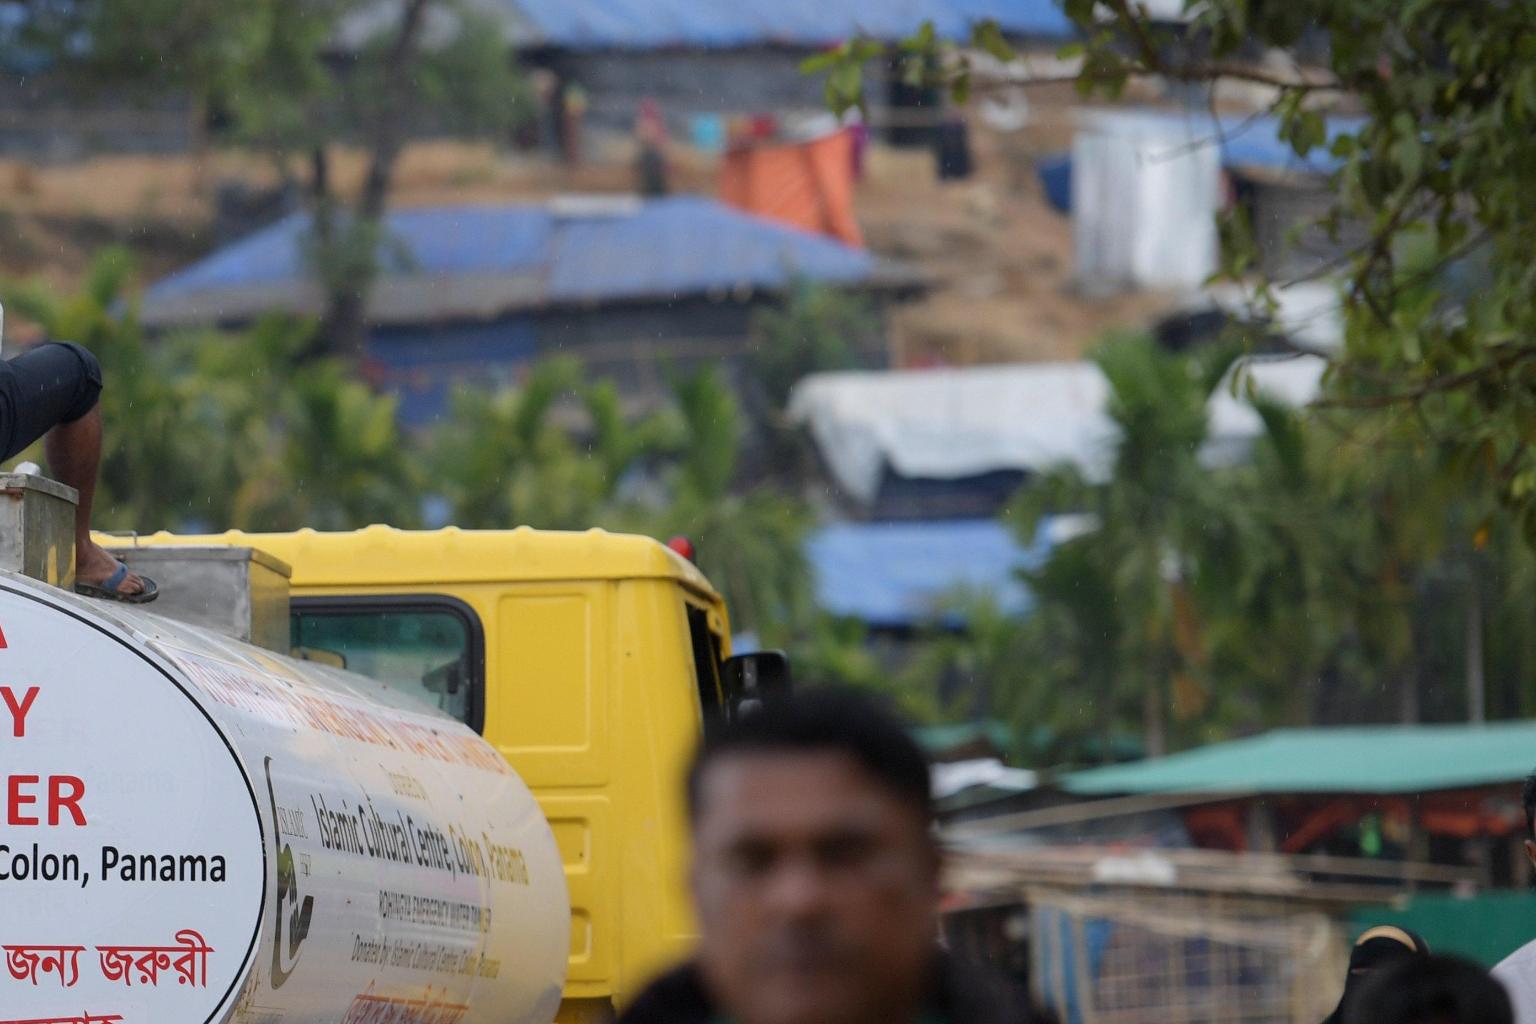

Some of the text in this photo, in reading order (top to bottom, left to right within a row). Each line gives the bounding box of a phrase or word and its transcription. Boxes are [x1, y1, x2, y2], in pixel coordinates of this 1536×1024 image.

[310, 792, 364, 856] Islamic
[358, 794, 414, 865] Cultural
[102, 848, 226, 883] Panama
[2, 945, 86, 987] জন্য
[95, 929, 214, 988] জরুরী
